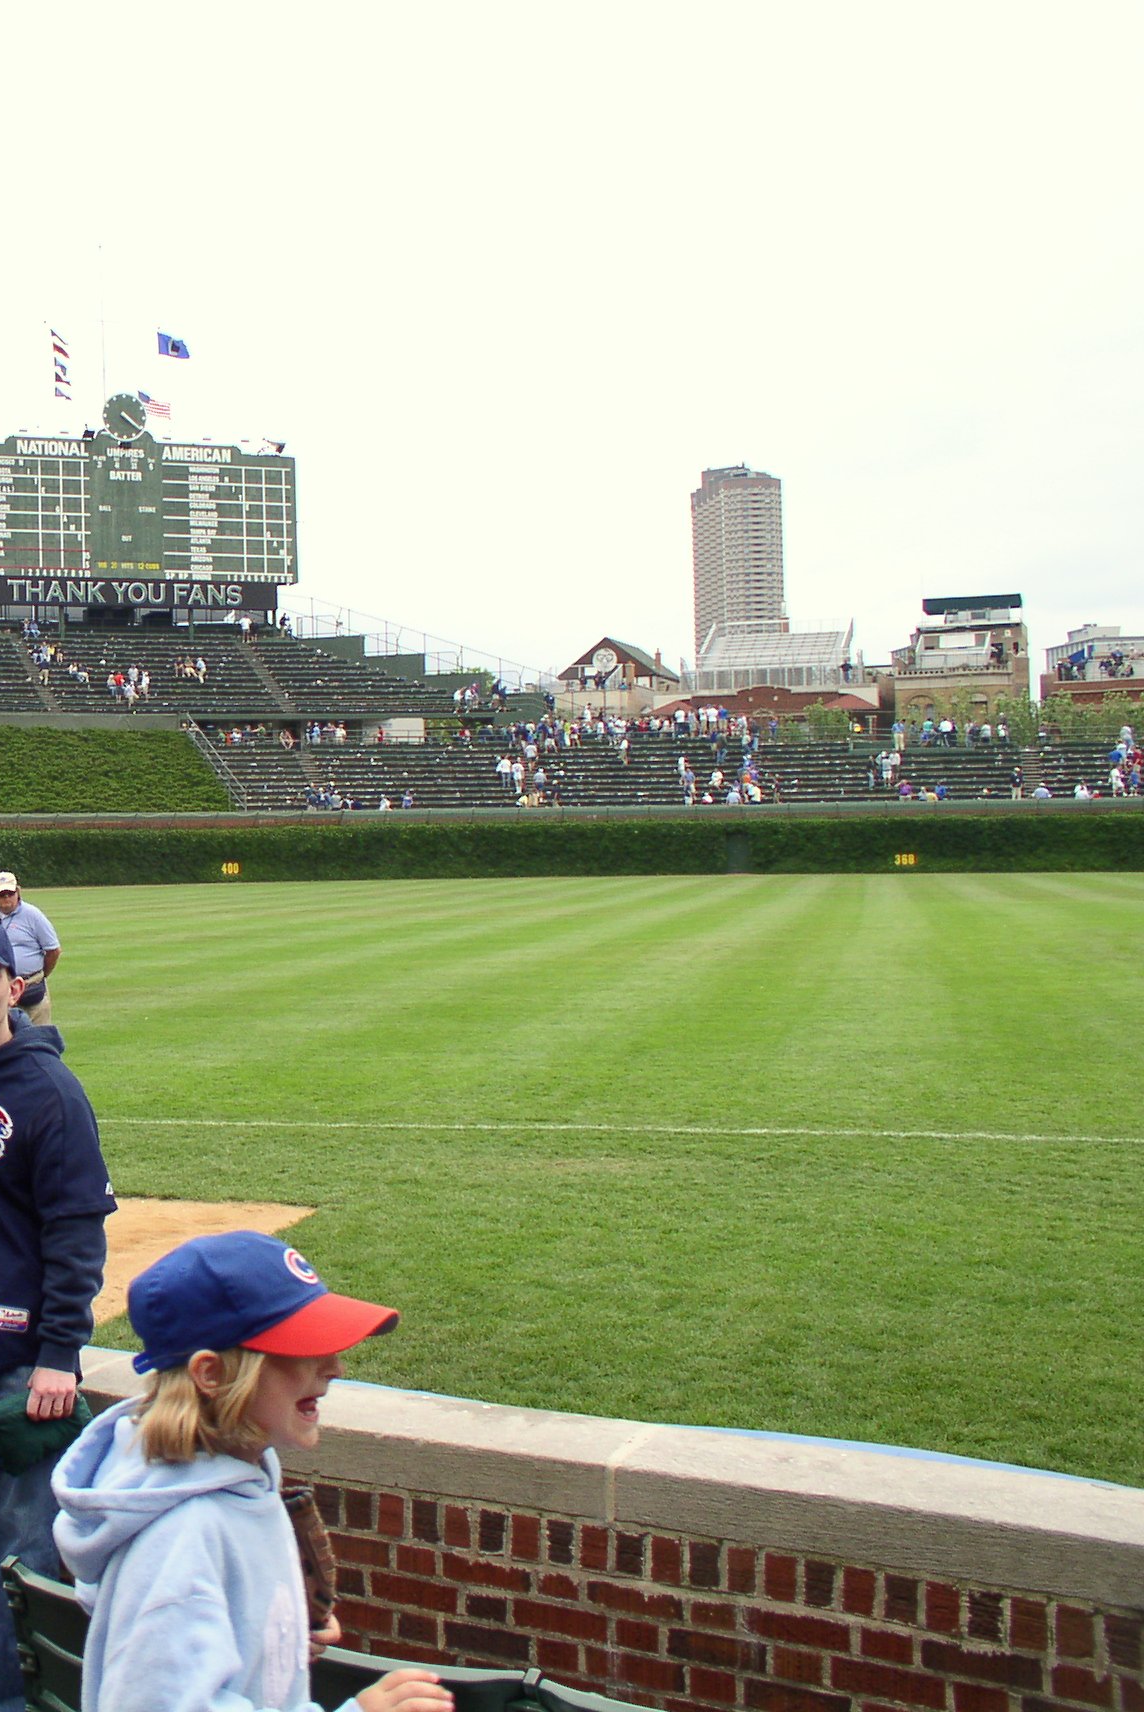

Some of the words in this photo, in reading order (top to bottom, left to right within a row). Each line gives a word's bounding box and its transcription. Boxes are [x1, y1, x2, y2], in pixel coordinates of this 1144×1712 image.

[17, 440, 89, 456] NATIONAL
[107, 447, 145, 459] UMPIRES
[162, 446, 233, 463] AMERICAN
[109, 470, 142, 481] BATTER
[7, 579, 107, 604] THANK
[110, 582, 164, 604] YOU
[173, 583, 243, 606] FANS
[221, 862, 239, 874] 400
[284, 1248, 318, 1284] C
